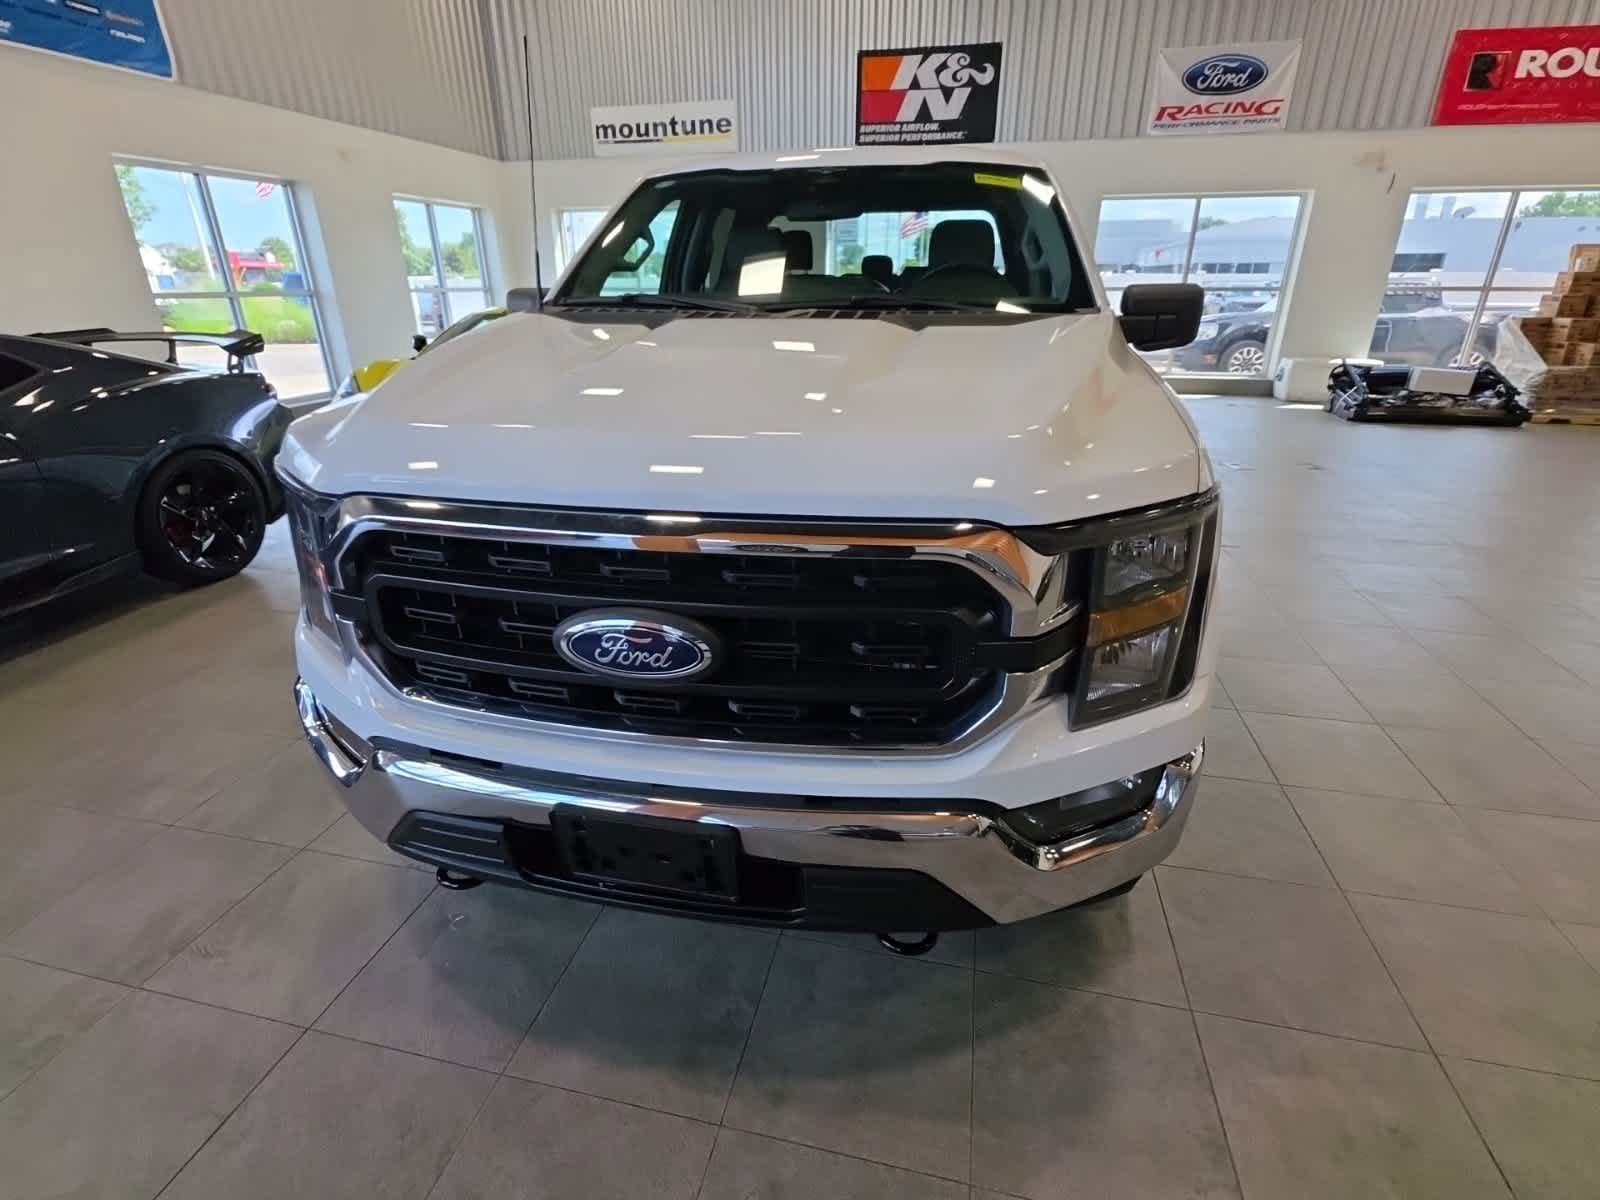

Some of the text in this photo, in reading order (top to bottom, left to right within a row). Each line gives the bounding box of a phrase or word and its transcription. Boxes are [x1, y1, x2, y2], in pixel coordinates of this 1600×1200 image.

[1196, 61, 1251, 90] Ford
[1155, 98, 1285, 122] RACING
[595, 115, 732, 140] mountune
[859, 124, 901, 134] SUPERIOR
[859, 133, 900, 143] SUPERIOR
[594, 633, 673, 668] Ford
